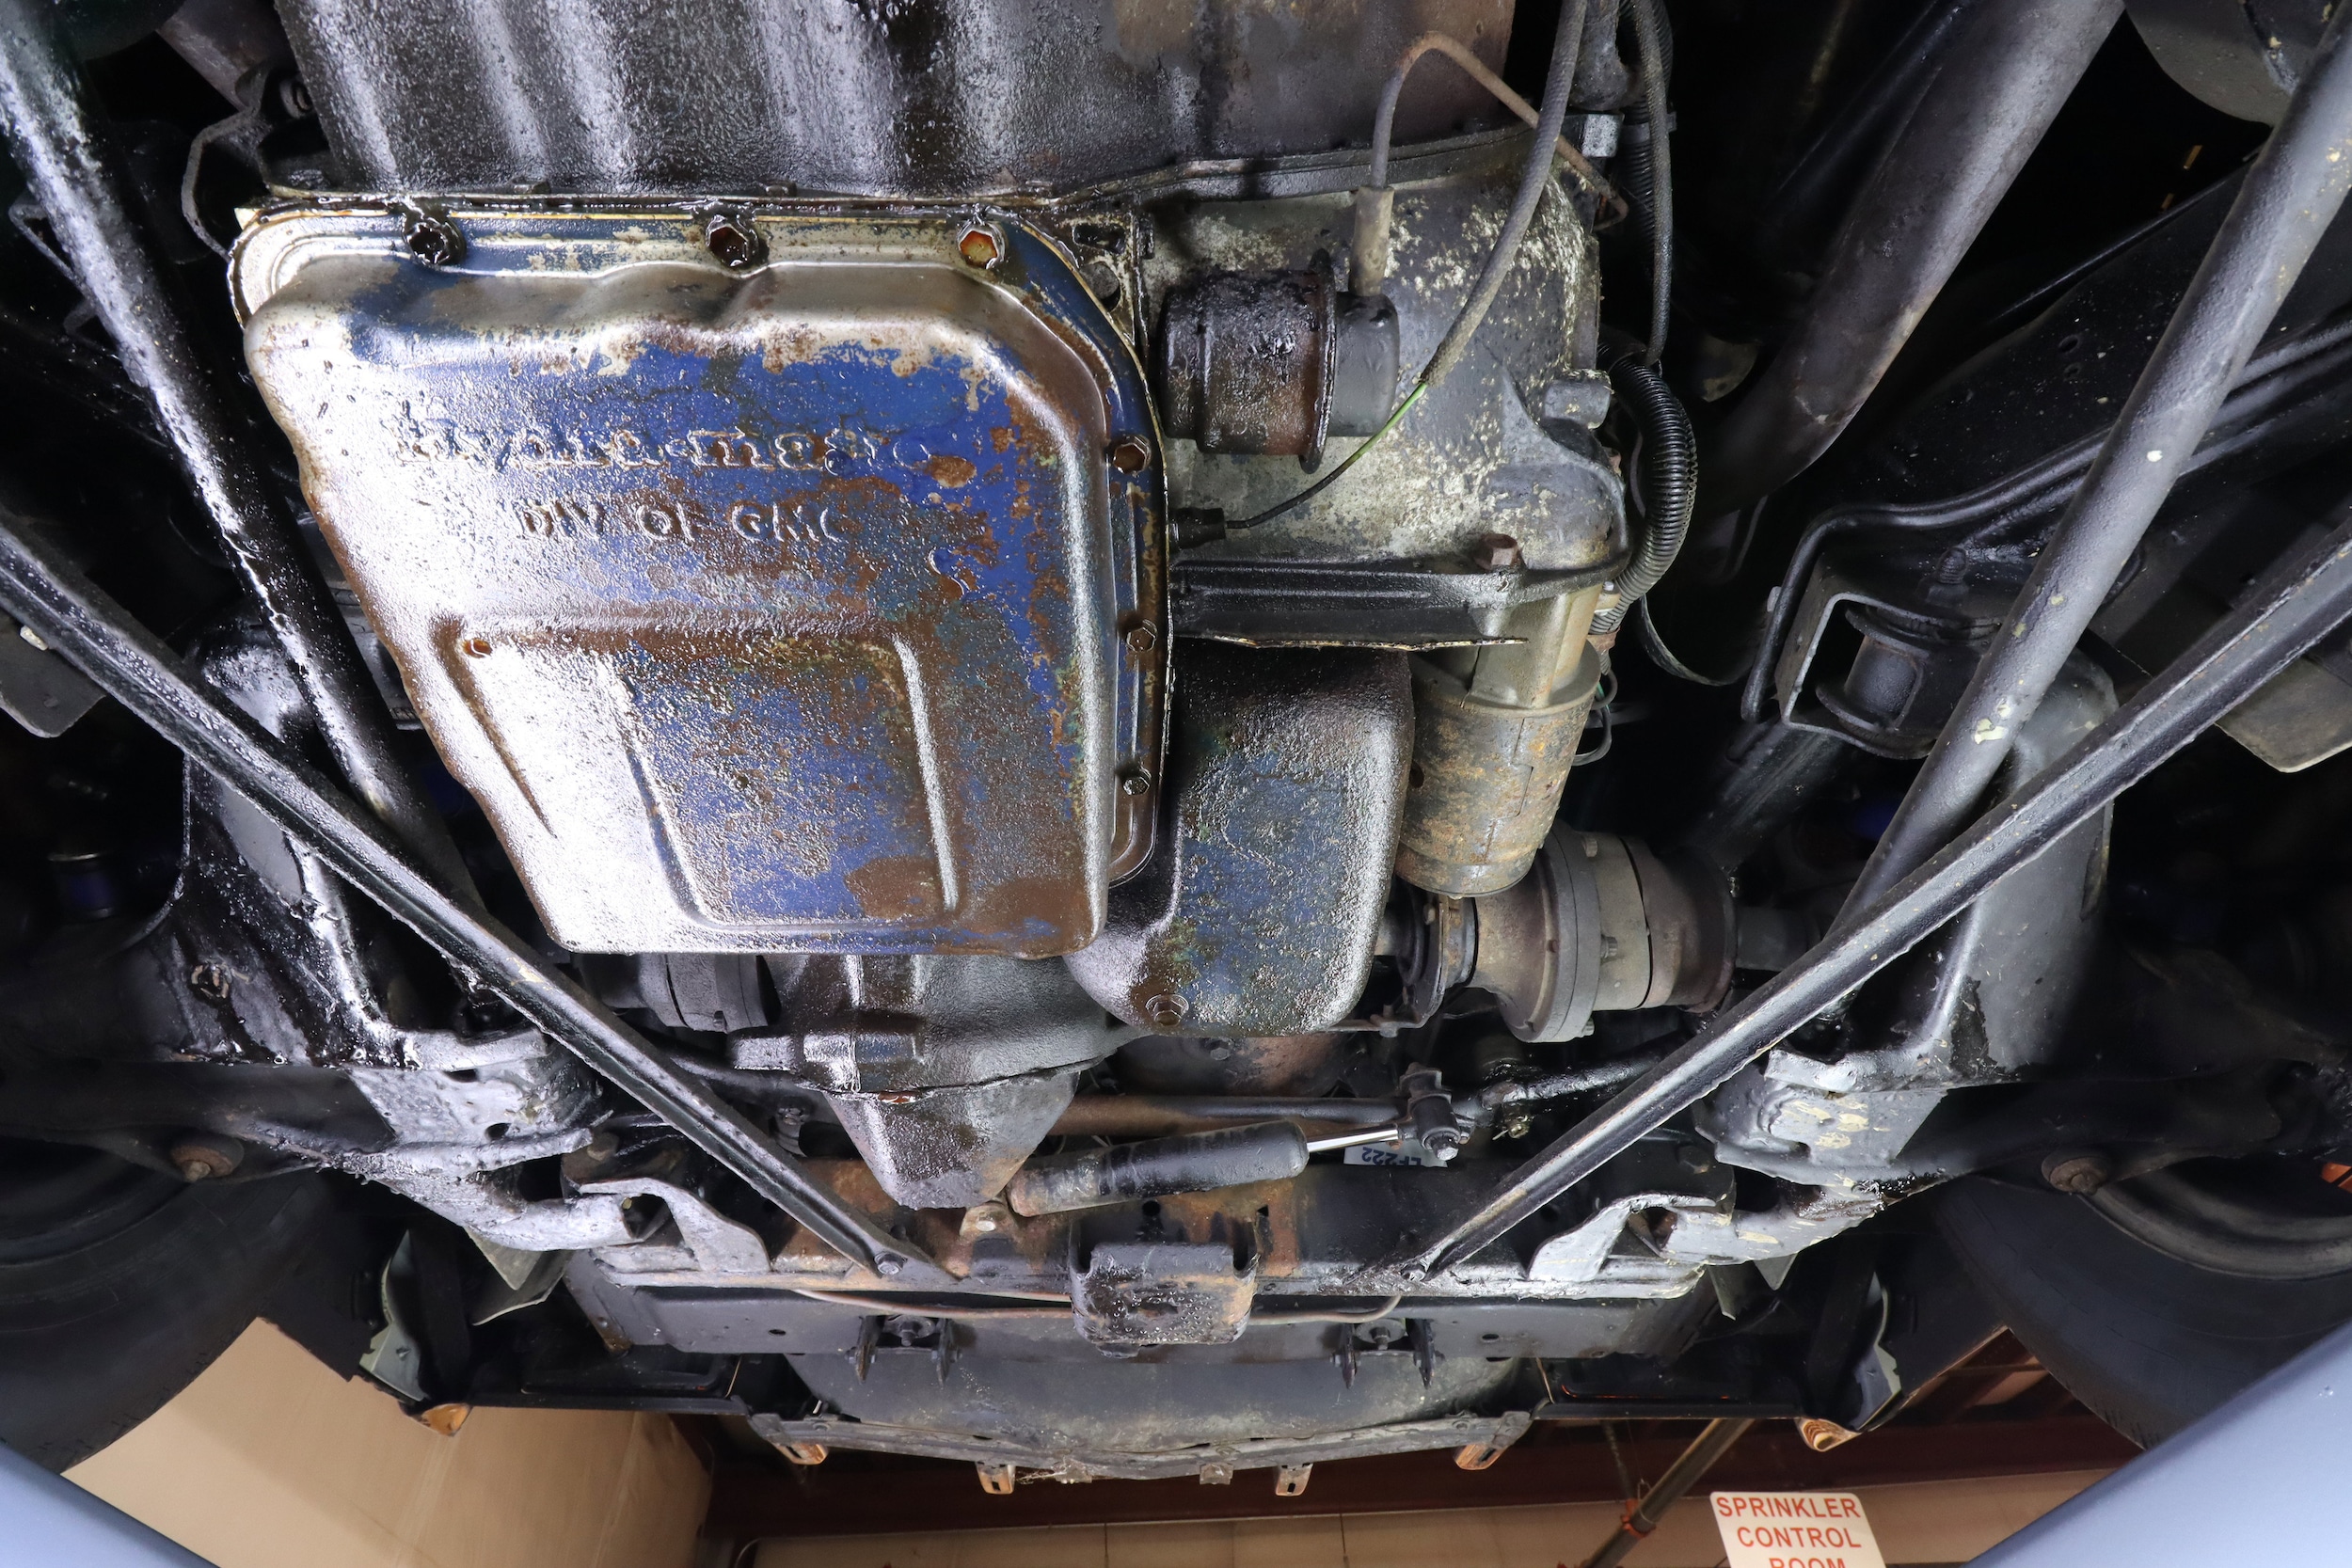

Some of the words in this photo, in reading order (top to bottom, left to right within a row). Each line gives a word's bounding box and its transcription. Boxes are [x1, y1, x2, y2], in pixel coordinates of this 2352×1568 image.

[730, 499, 849, 544] GMC
[1716, 1497, 1861, 1518] SPRINKLER
[1737, 1527, 1862, 1548] CONTROL
